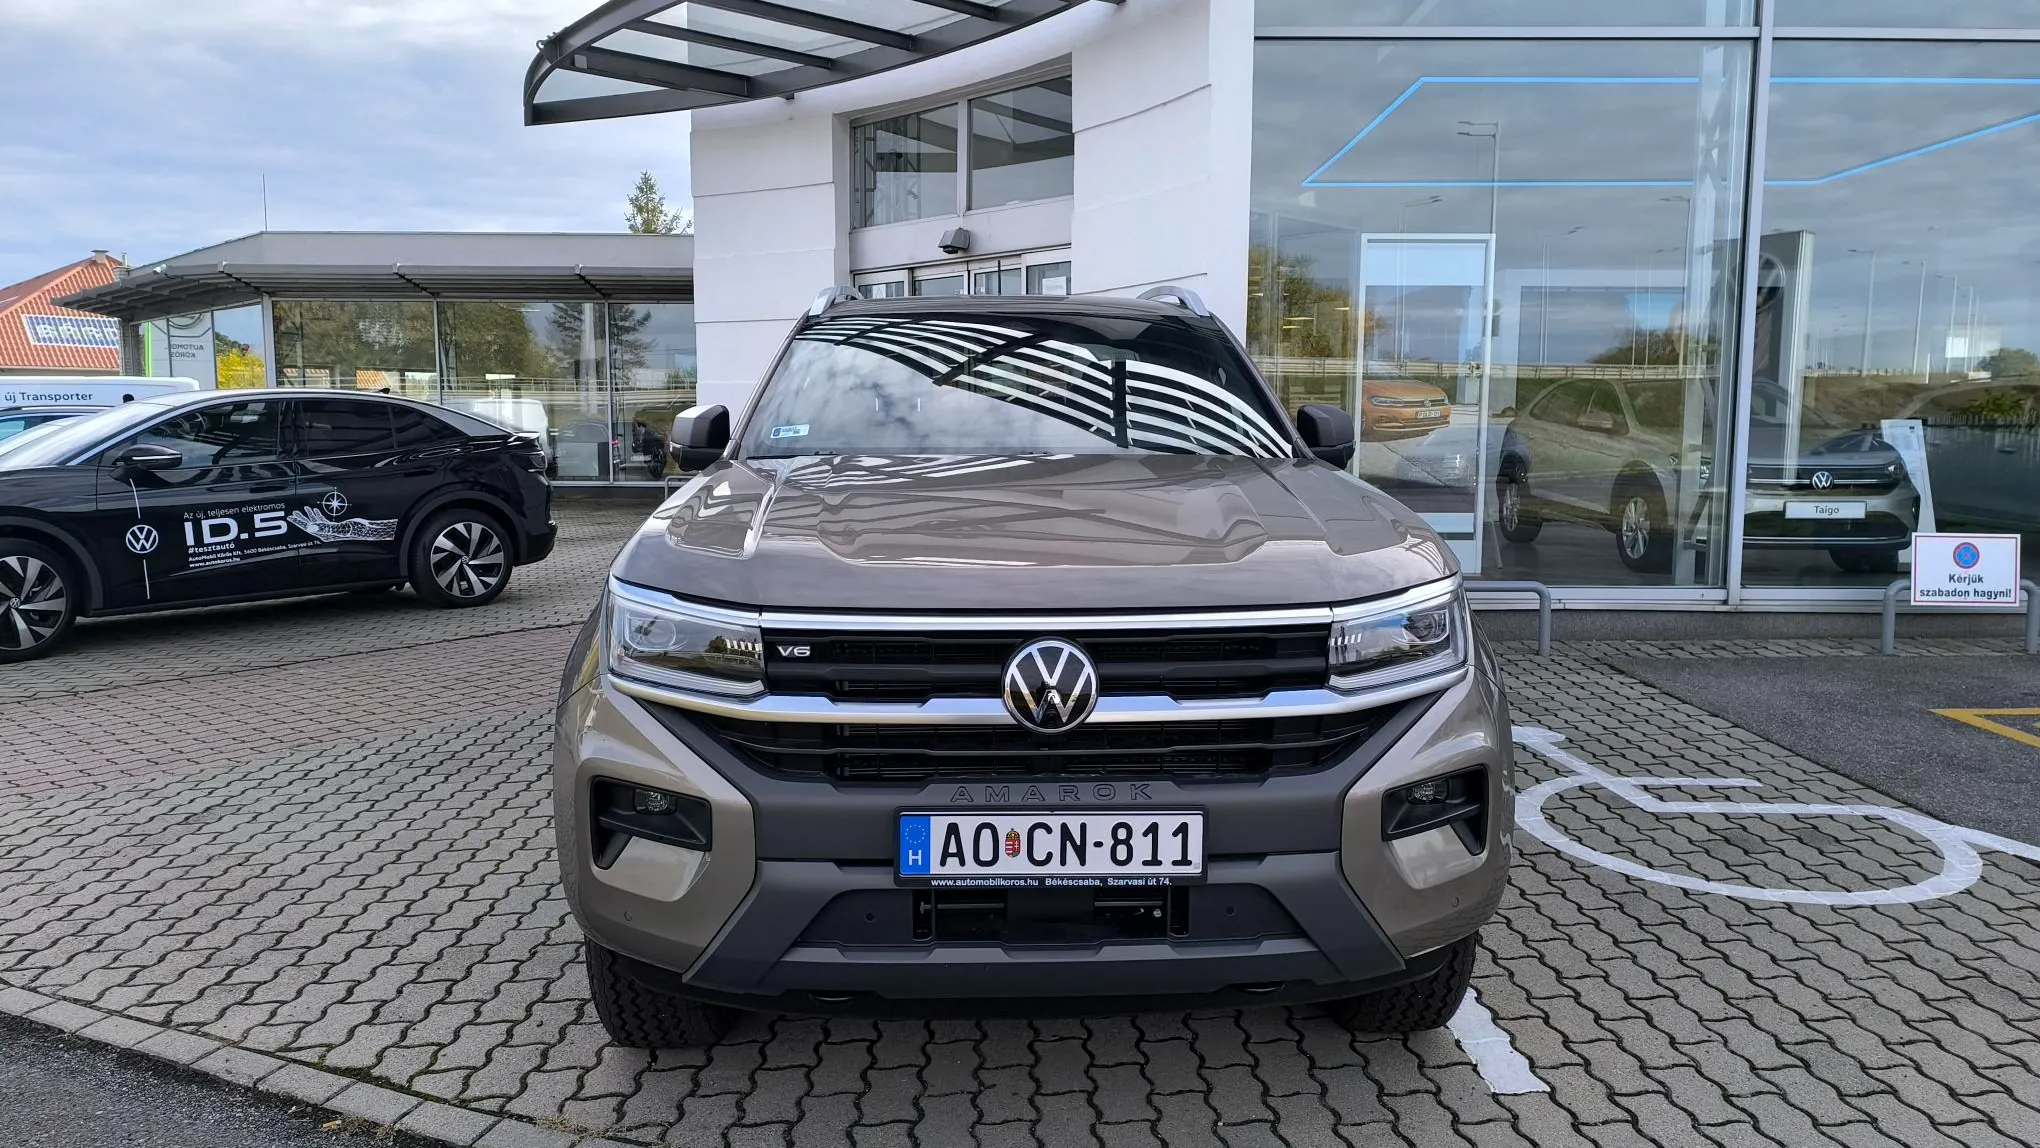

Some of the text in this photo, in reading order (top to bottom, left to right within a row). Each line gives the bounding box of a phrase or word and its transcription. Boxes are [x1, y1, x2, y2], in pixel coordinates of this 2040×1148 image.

[4, 391, 93, 403] új Transporter
[183, 511, 193, 519] Az
[208, 506, 240, 518] teljesen
[241, 502, 285, 513] elektromos
[1814, 505, 1840, 515] Taigo
[184, 510, 288, 546] ID.5
[188, 541, 235, 554] #tesztautó
[1948, 573, 1984, 585] Kérjük
[1919, 587, 2012, 600] szabadon hagyni!
[776, 645, 811, 658] V6
[950, 783, 1153, 802] AMAROK
[908, 849, 922, 866] H
[931, 877, 1039, 887] www.automobilkoros.hu
[1045, 877, 1103, 888] Békéscsaba,
[1107, 877, 1146, 886] Szarvasi
[1159, 877, 1172, 886] 74.
